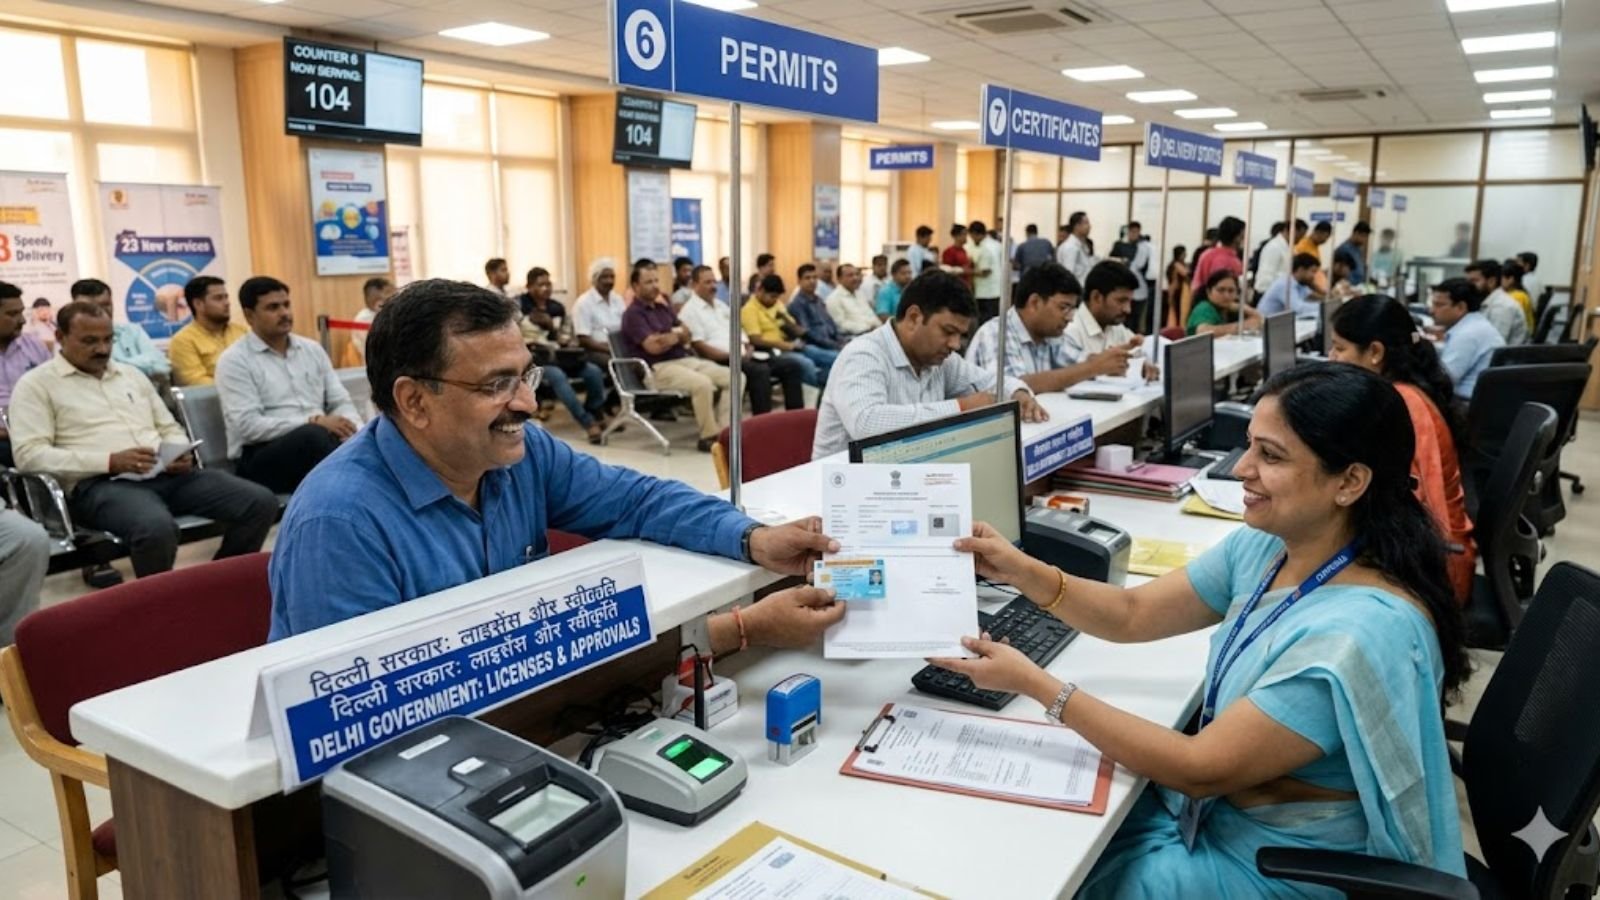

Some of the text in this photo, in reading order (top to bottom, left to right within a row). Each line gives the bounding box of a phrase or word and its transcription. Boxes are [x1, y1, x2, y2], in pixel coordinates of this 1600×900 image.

[293, 45, 349, 64] COUNTER
[636, 20, 839, 96] 6 PERMITS
[290, 61, 316, 75] NOW
[305, 81, 351, 111] 104
[625, 123, 653, 146] 104
[993, 104, 1100, 147] 7 CERTIFICATES
[875, 150, 928, 165] PERMITS
[14, 235, 54, 248] Speedy
[121, 238, 210, 253] 23 New Services
[16, 249, 65, 263] Delivery
[329, 679, 387, 722] दिल्ली
[395, 659, 462, 696] सरकार:
[535, 619, 563, 645] और
[309, 616, 641, 763] DELHI GOVERNMENT: LICENSES & APPROVALS
